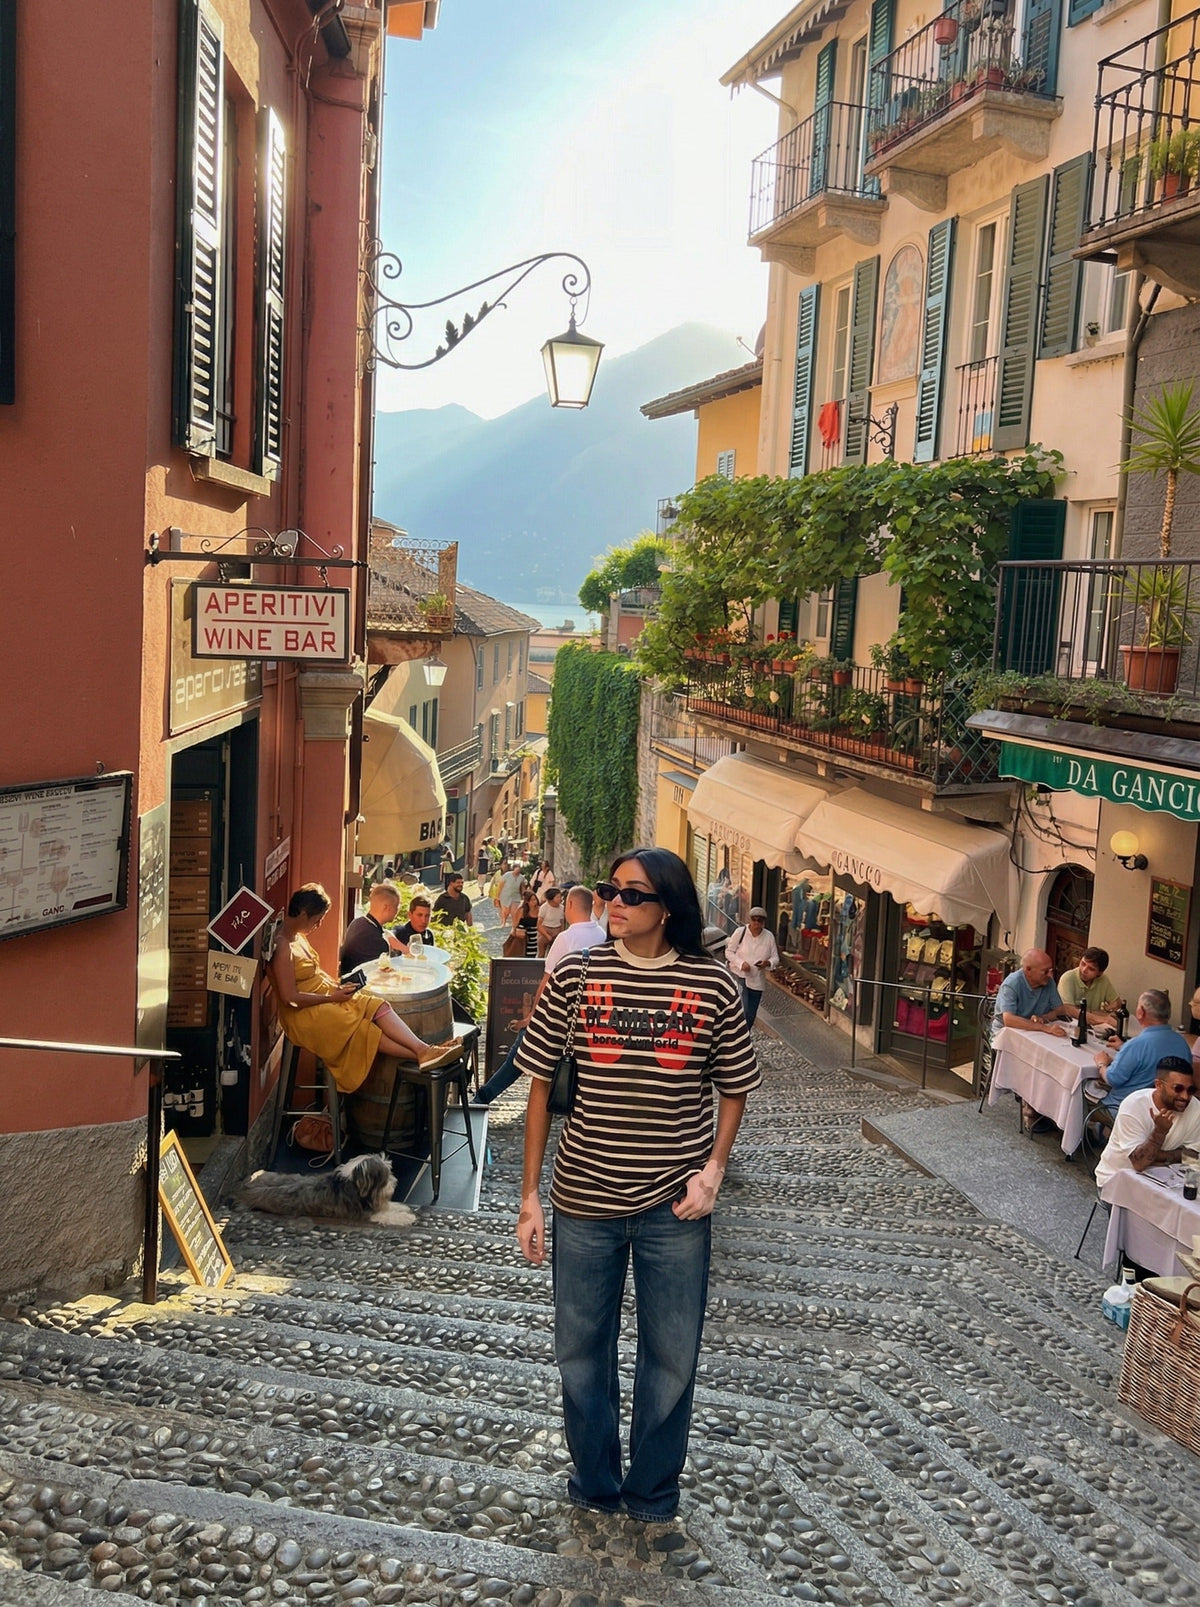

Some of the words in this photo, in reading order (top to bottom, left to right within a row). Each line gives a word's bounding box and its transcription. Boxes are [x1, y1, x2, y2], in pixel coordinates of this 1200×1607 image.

[204, 591, 335, 617] APERITIVI
[204, 627, 272, 650] WINE
[284, 629, 336, 653] BAR
[1066, 759, 1099, 792] DA
